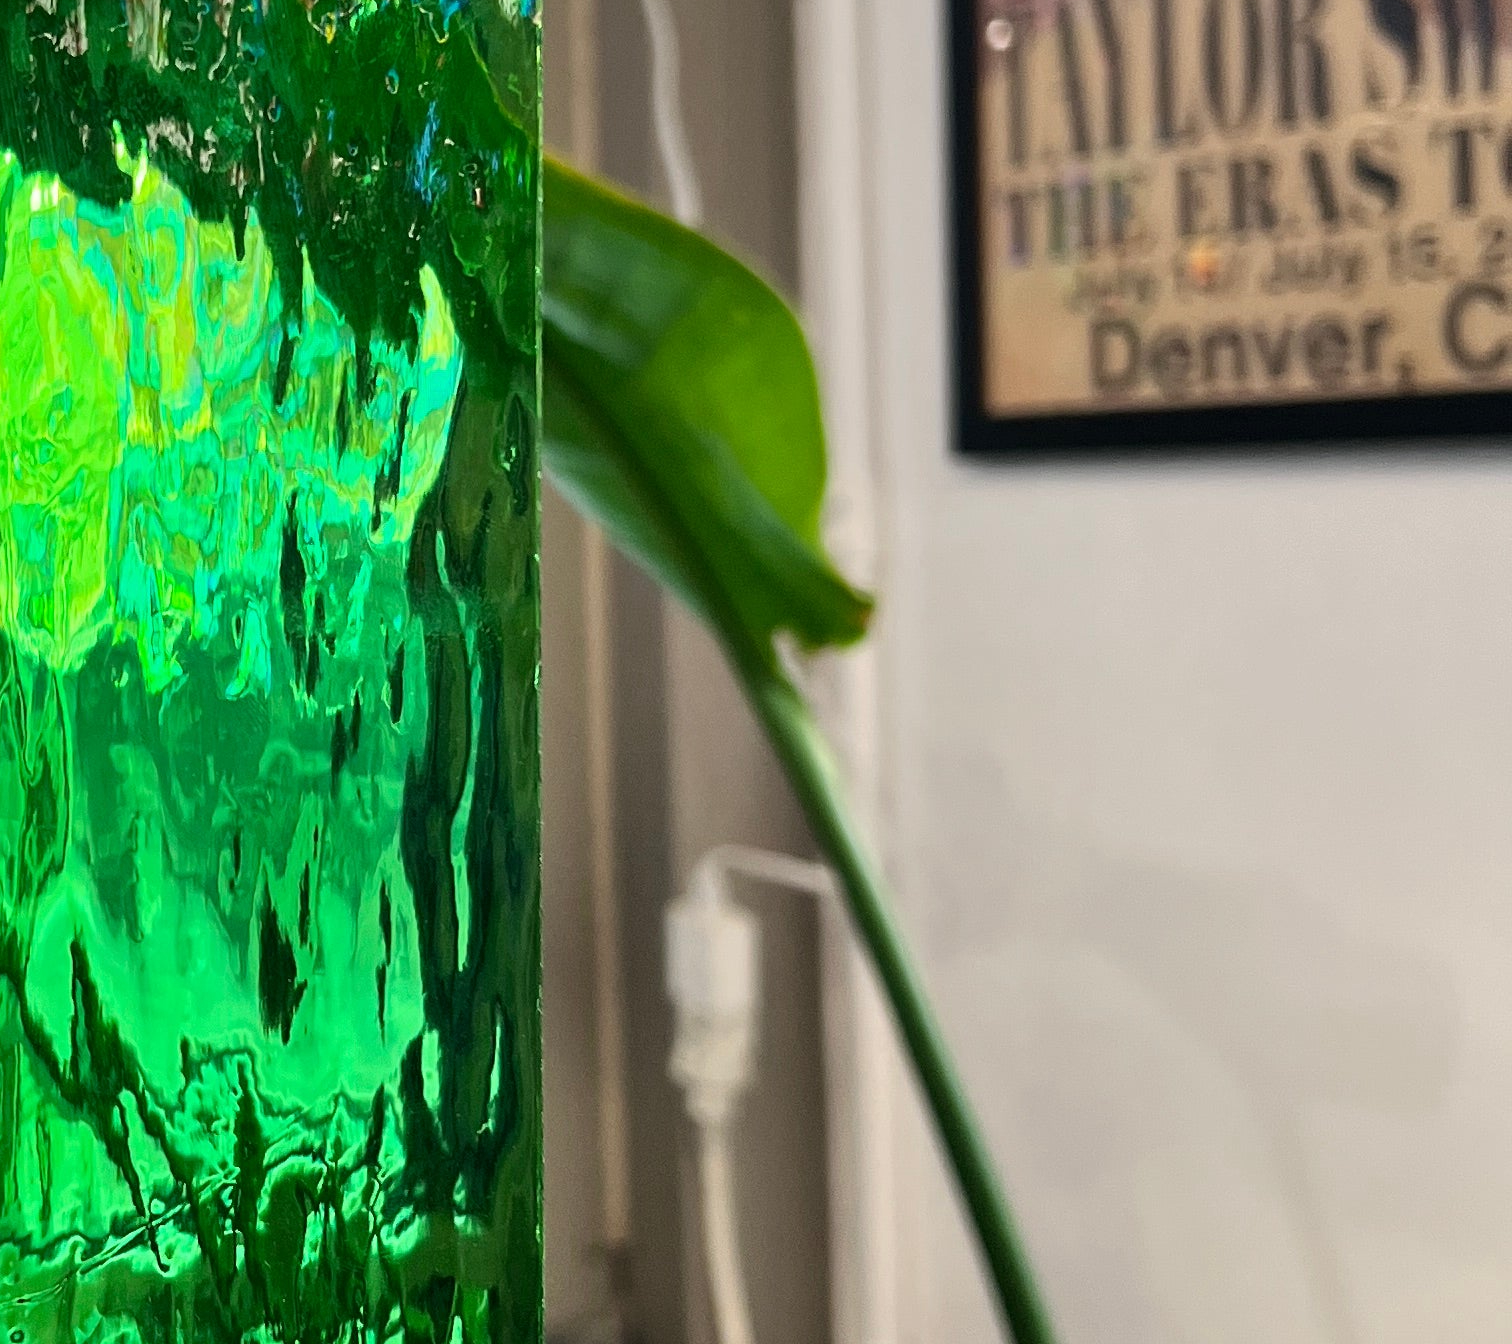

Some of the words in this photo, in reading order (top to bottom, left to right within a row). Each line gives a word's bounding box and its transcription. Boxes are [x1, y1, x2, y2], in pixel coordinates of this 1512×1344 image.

[990, 164, 1156, 267] THE
[1176, 136, 1402, 237] ERAS
[1090, 306, 1418, 396] Denver,
